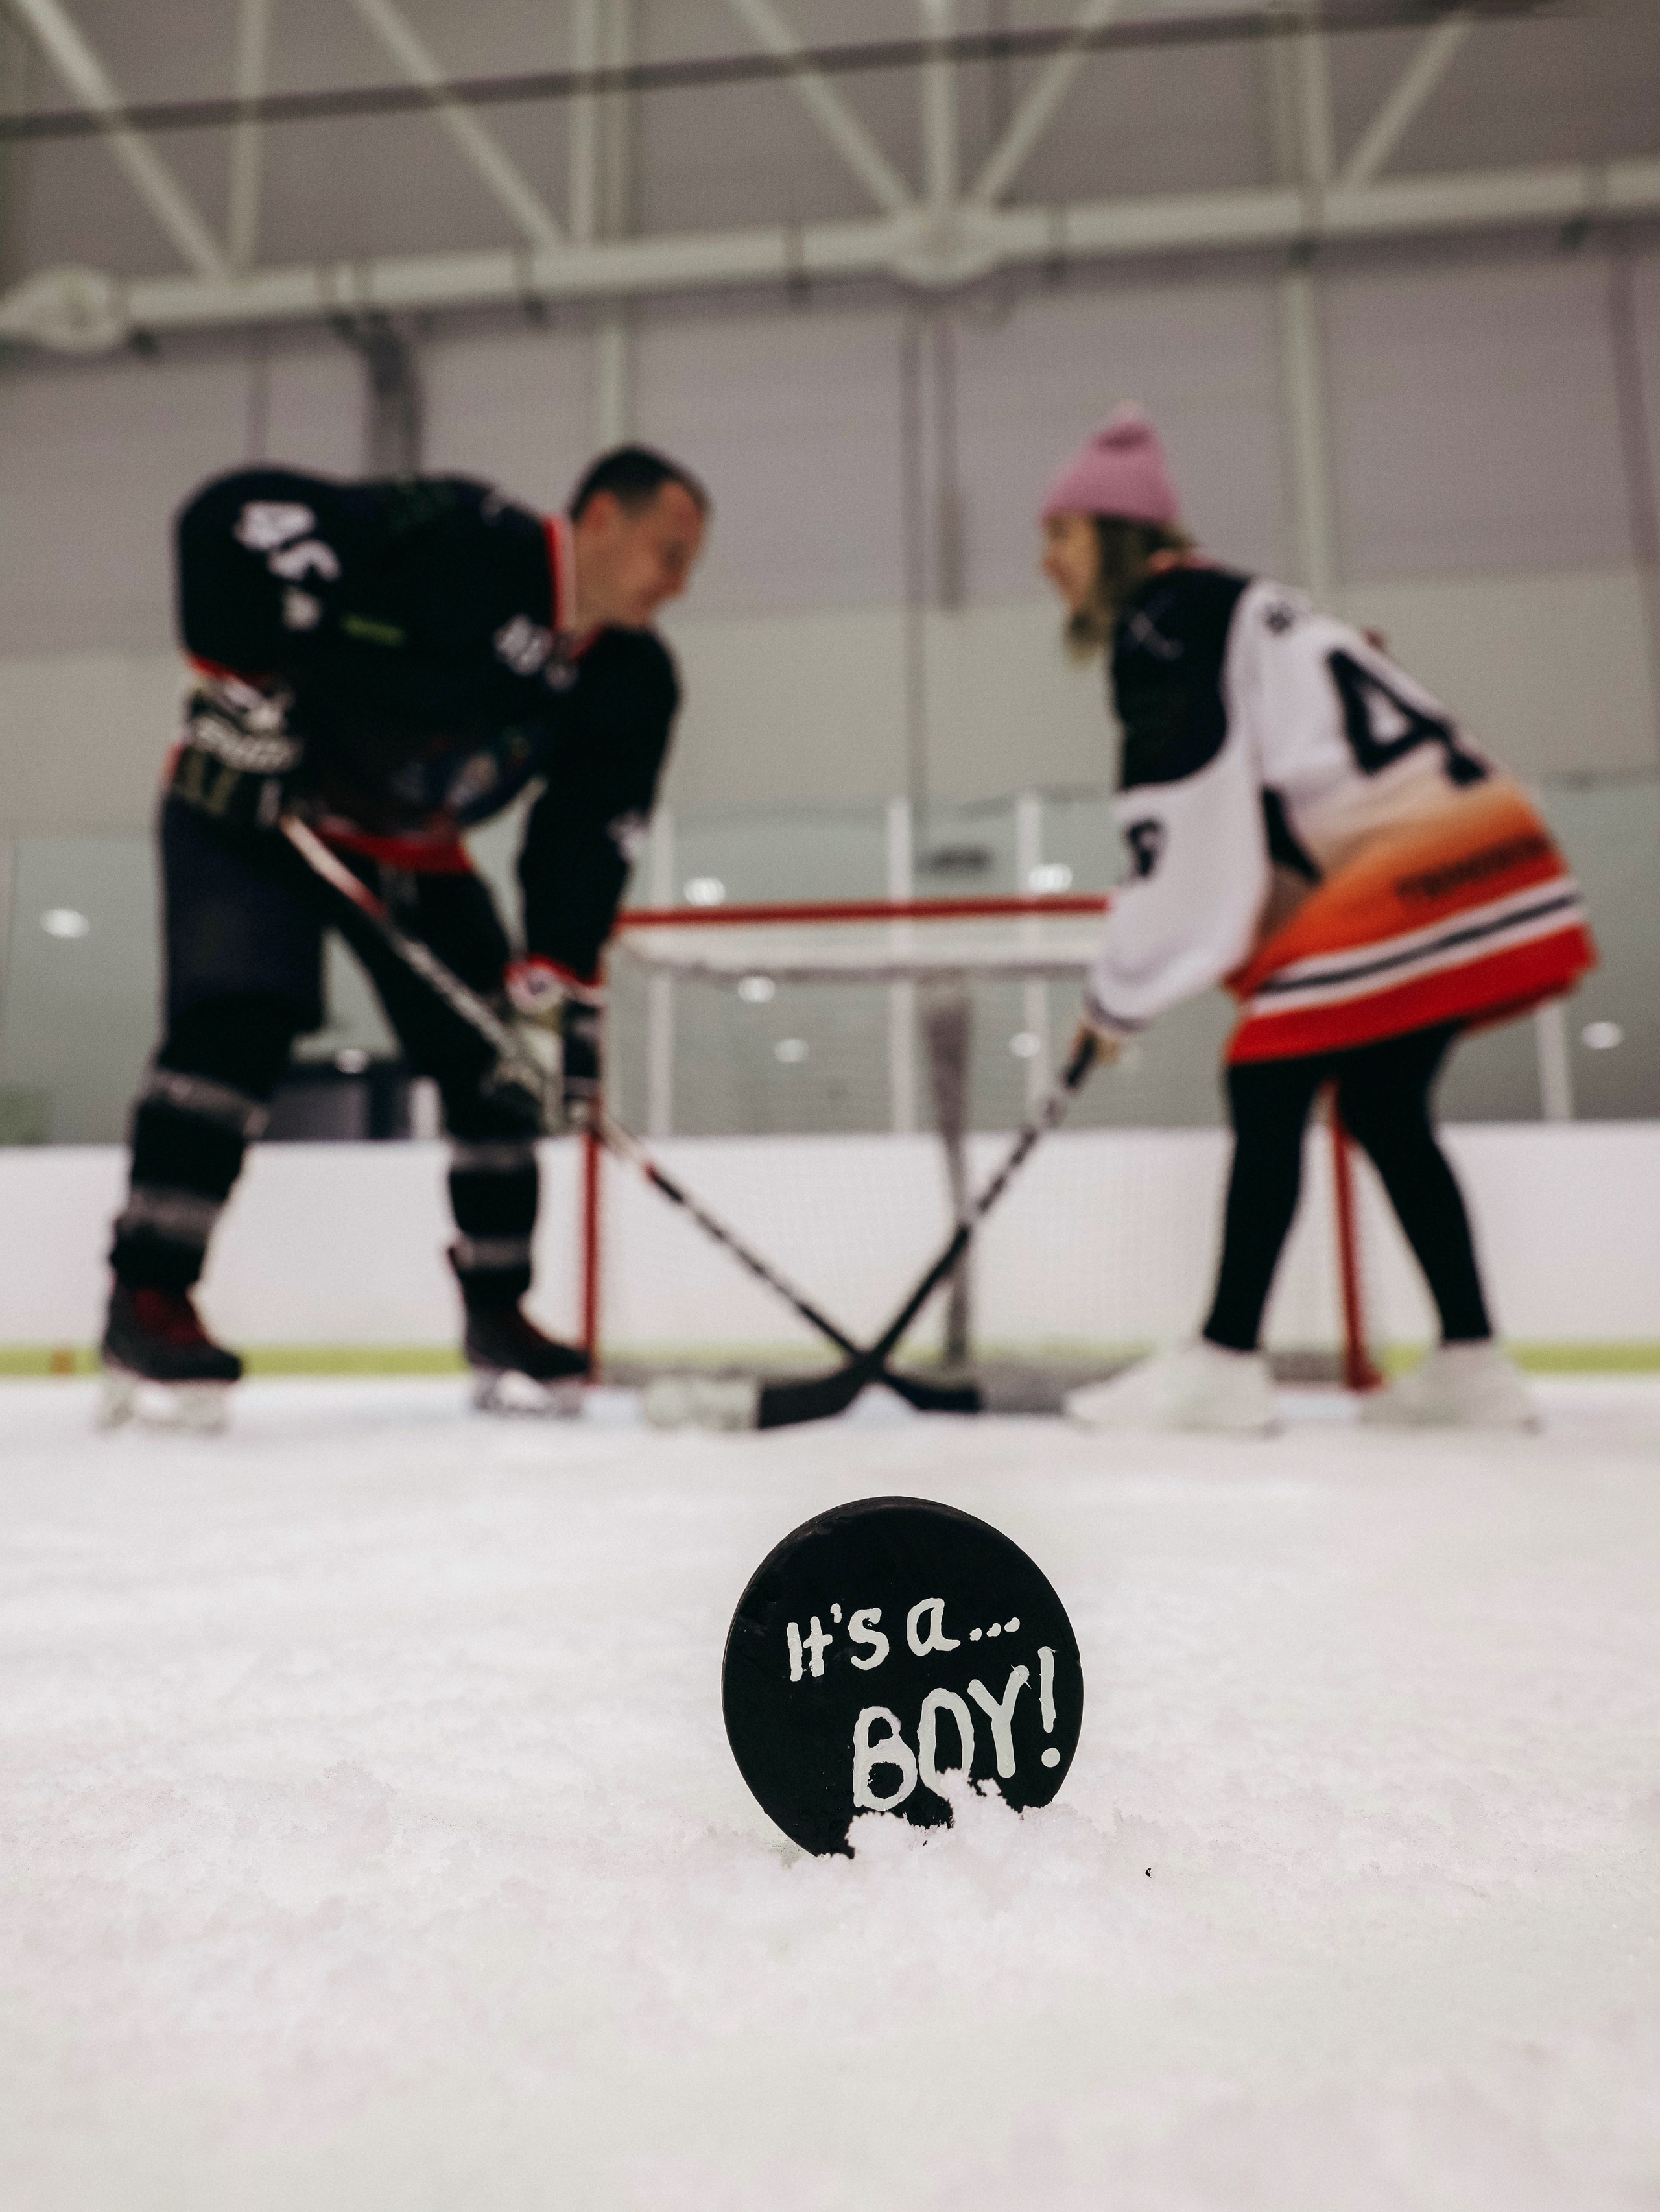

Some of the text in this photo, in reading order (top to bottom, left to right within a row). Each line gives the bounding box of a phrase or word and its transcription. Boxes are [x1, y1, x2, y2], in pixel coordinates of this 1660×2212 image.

[786, 1597, 1021, 1682] It's a...
[852, 1645, 1061, 1811] BOY!
